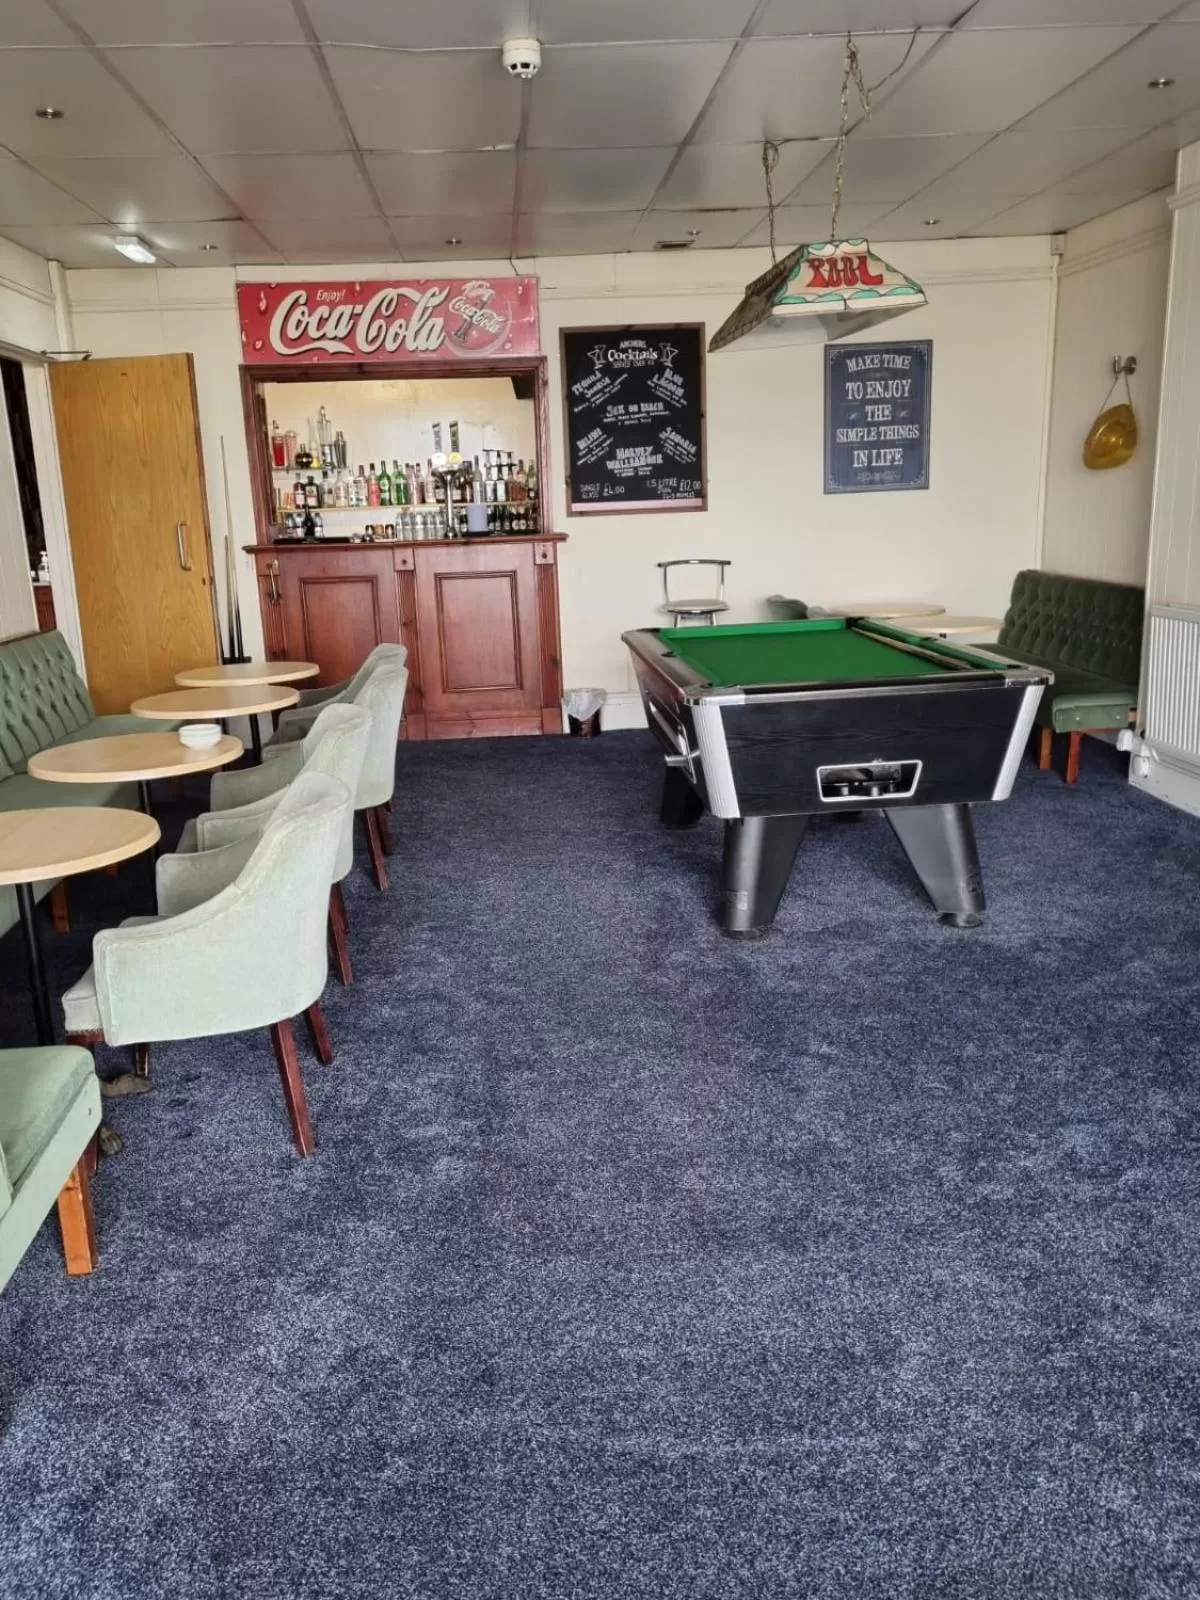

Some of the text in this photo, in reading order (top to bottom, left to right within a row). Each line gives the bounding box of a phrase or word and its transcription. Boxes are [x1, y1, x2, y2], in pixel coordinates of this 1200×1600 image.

[807, 255, 884, 288] POOL
[316, 288, 346, 302] Enjoy!
[268, 285, 451, 356] Coca-Cola
[449, 296, 505, 334] Coca-Cola
[608, 347, 658, 362] Cocktails
[845, 354, 912, 373] MAKE TIME
[845, 379, 912, 400] TO ENJOY
[865, 404, 892, 422] THE
[836, 424, 920, 443] SIMPLE THINGS
[852, 448, 904, 468] IN LIFE
